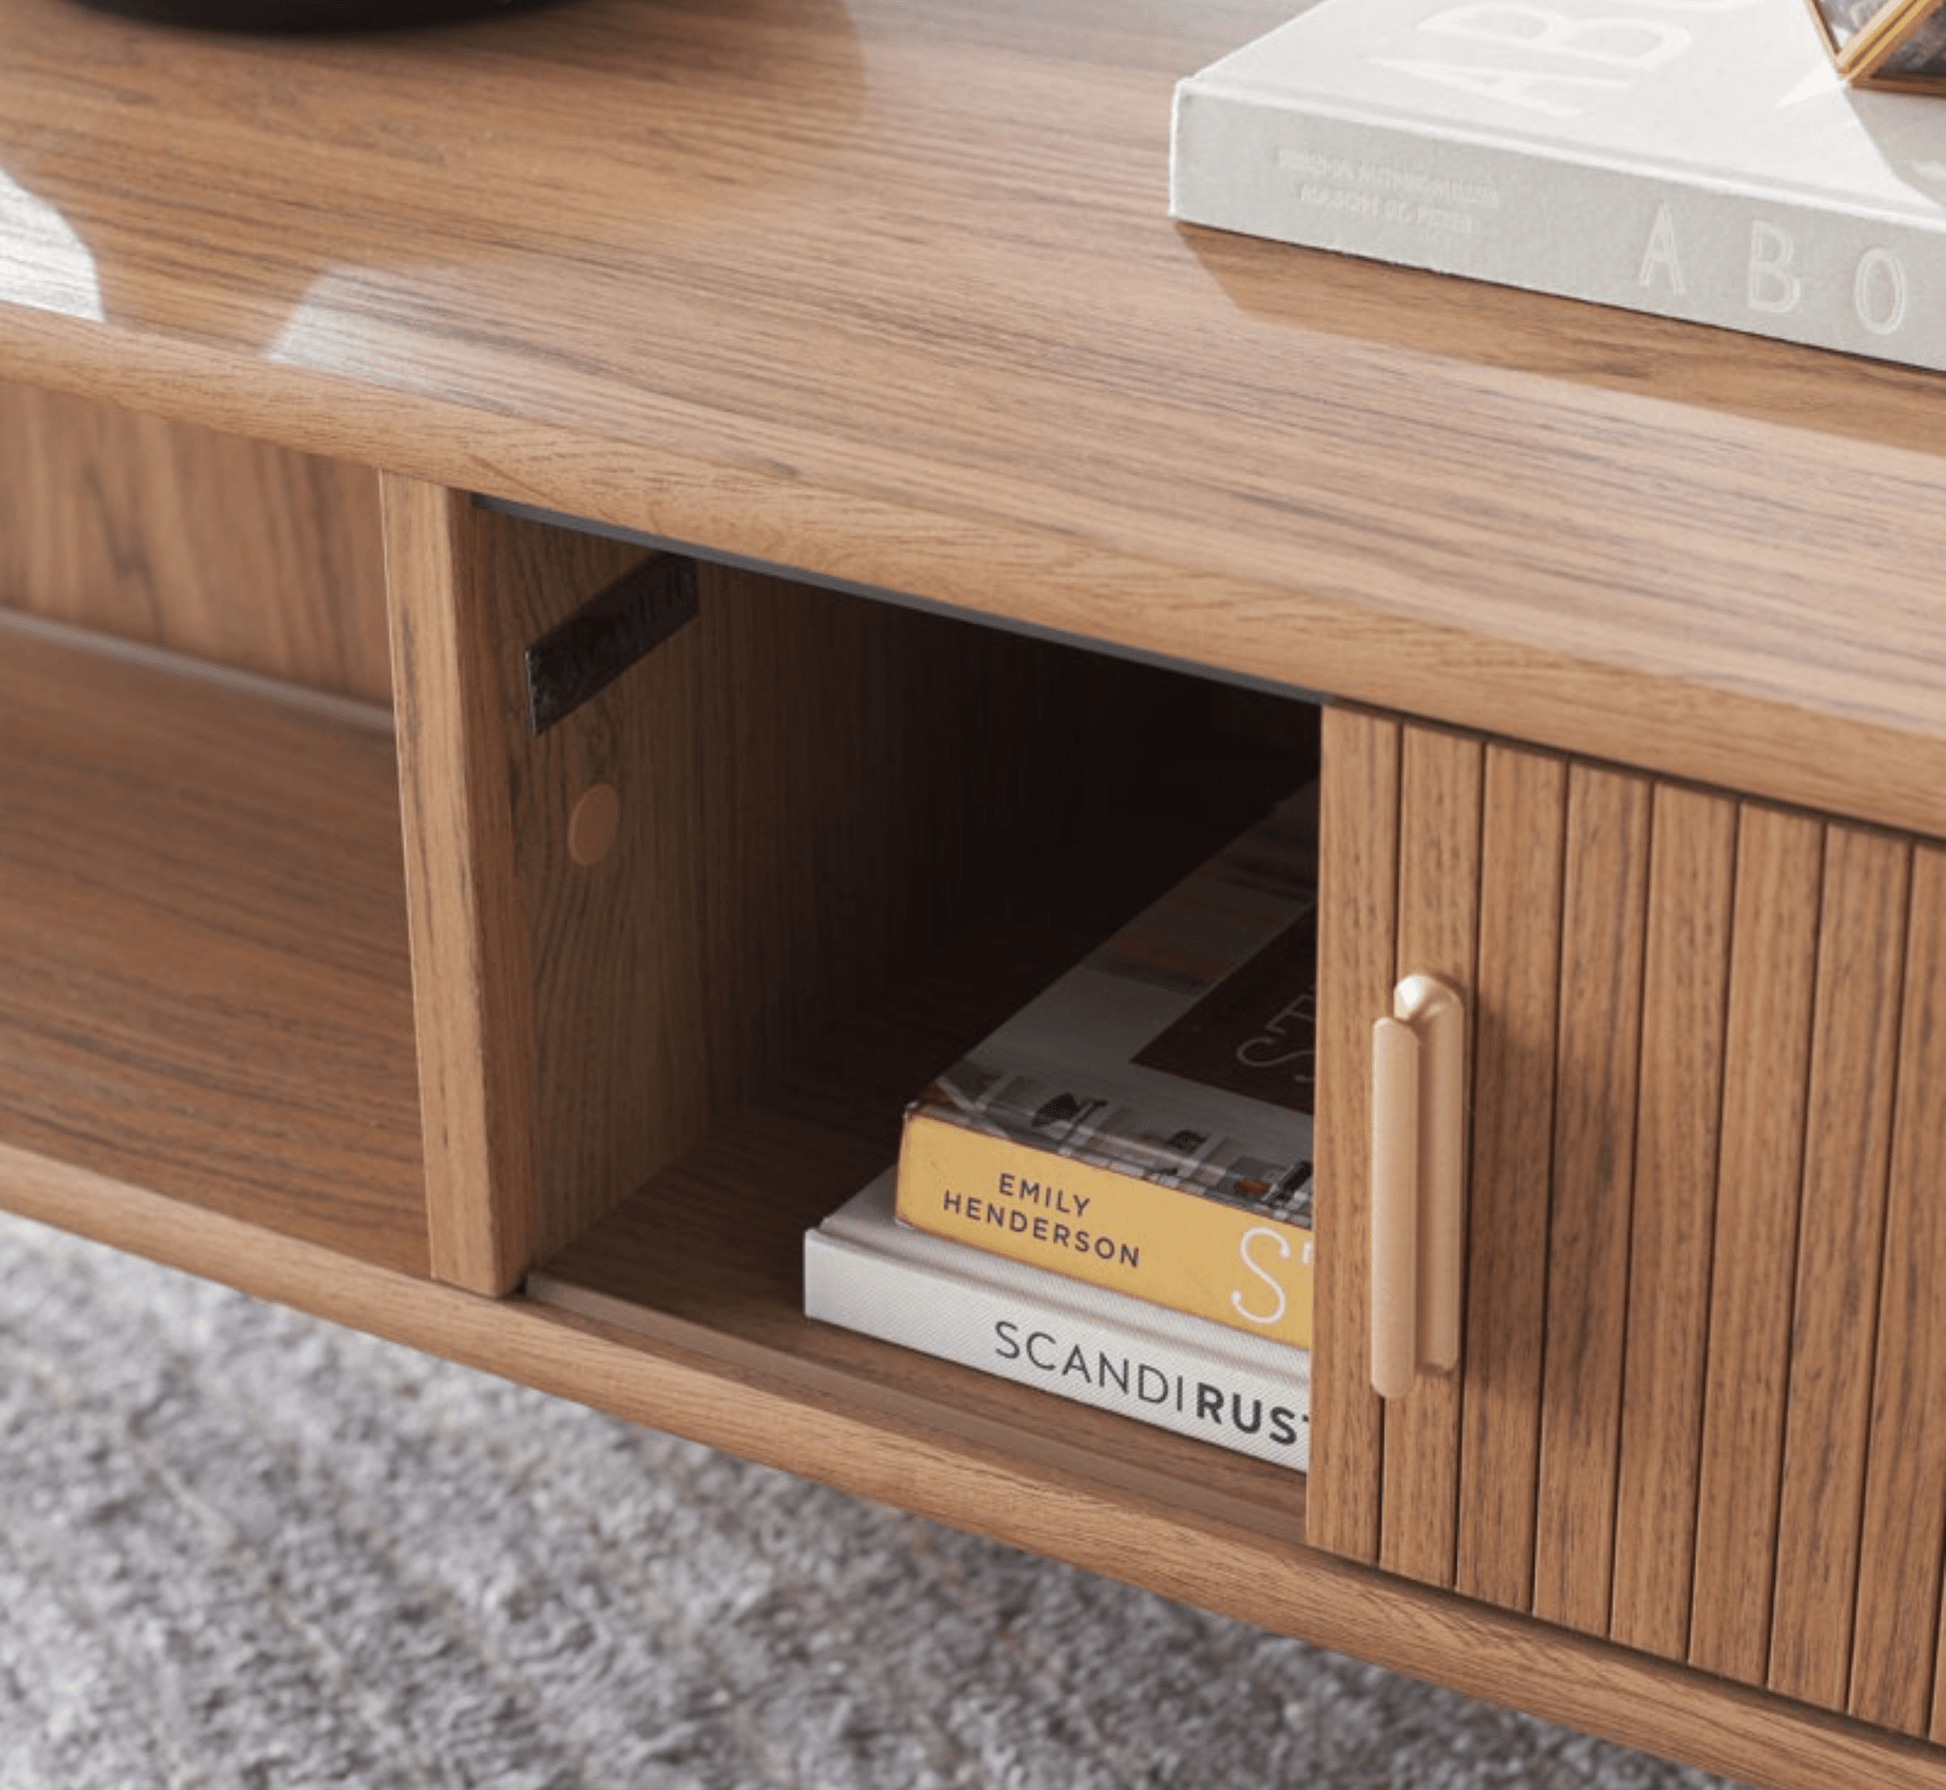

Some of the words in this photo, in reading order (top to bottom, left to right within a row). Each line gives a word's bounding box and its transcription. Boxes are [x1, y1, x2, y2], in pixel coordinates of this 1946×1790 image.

[1359, 0, 1762, 117] AB
[943, 1189, 1140, 1268] HENDERSON
[999, 1172, 1090, 1218] EMILY
[1231, 1226, 1313, 1325] S
[994, 1320, 1309, 1446] SCANDIRUS
